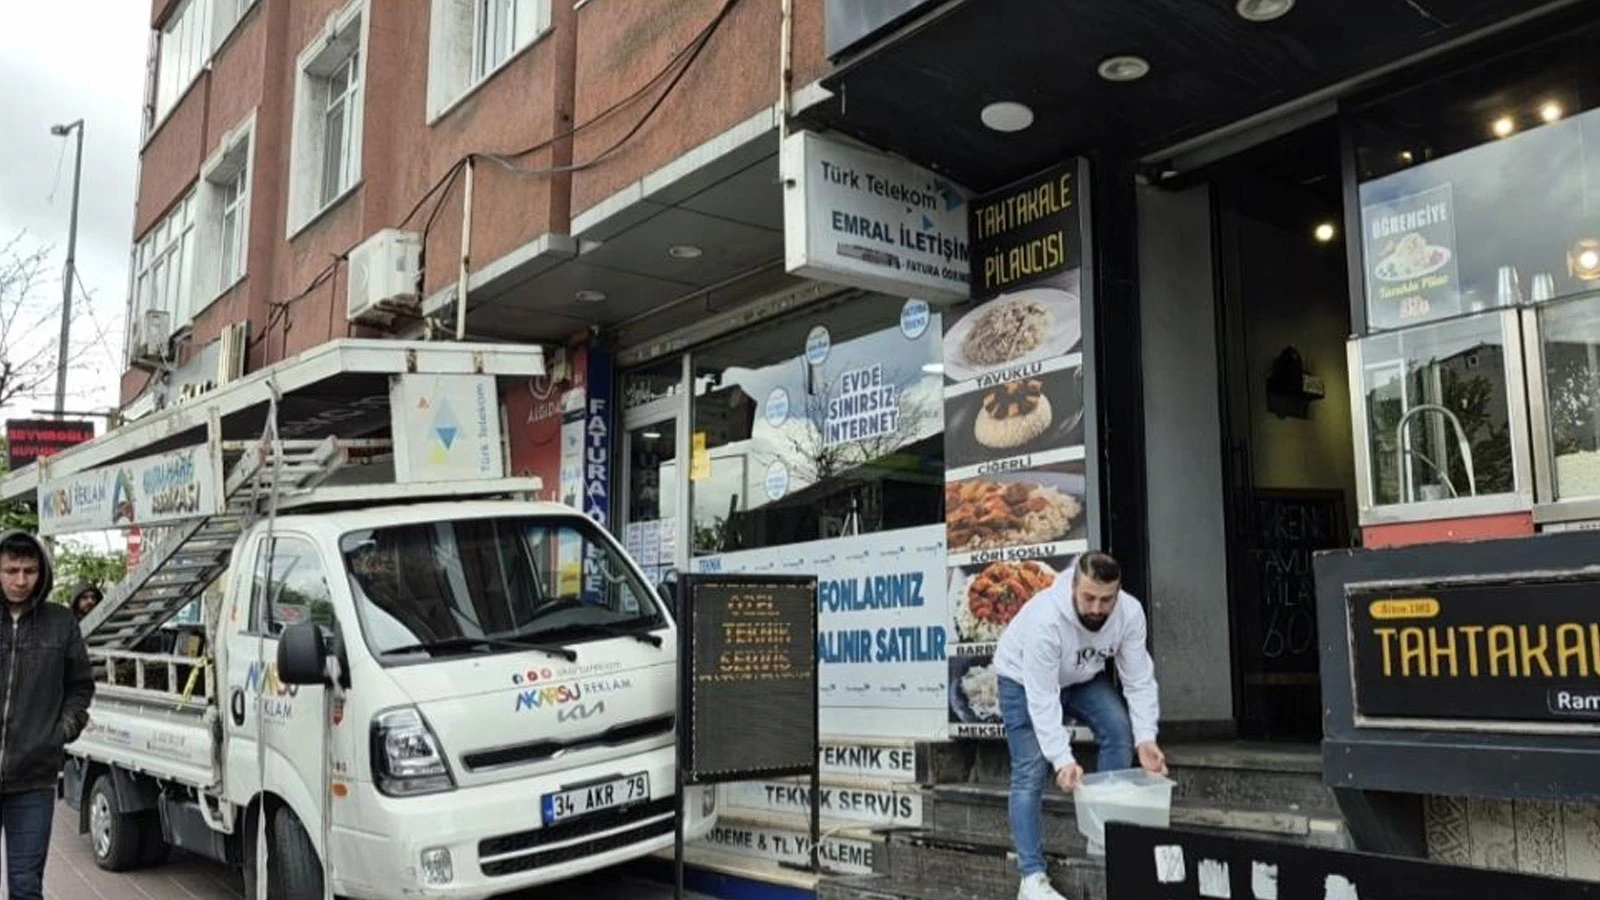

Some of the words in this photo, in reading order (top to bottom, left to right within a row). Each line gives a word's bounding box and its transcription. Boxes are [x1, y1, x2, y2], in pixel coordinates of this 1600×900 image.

[820, 160, 860, 190] Türk
[866, 174, 938, 212] Telekom
[975, 171, 1072, 240] TAHTAKALE
[831, 210, 895, 247] EMRAL
[905, 258, 941, 278] FATURA
[842, 366, 882, 394] EVDE
[977, 362, 1043, 387] TAVUKLU
[829, 386, 896, 421] SINIRSIZ
[587, 399, 607, 497] FATURA
[819, 571, 925, 613] FONLARINIZ
[818, 629, 872, 664] ALINIR
[875, 625, 947, 663] SATILIR
[514, 683, 582, 713] AKARSU
[583, 678, 633, 695] REKLAM
[888, 751, 913, 771] SE
[555, 795, 576, 816] 34
[586, 785, 614, 810] AKR
[626, 776, 645, 799] 79
[765, 785, 834, 809] TEKNK
[838, 790, 913, 819] SERVİS
[757, 831, 767, 848] &
